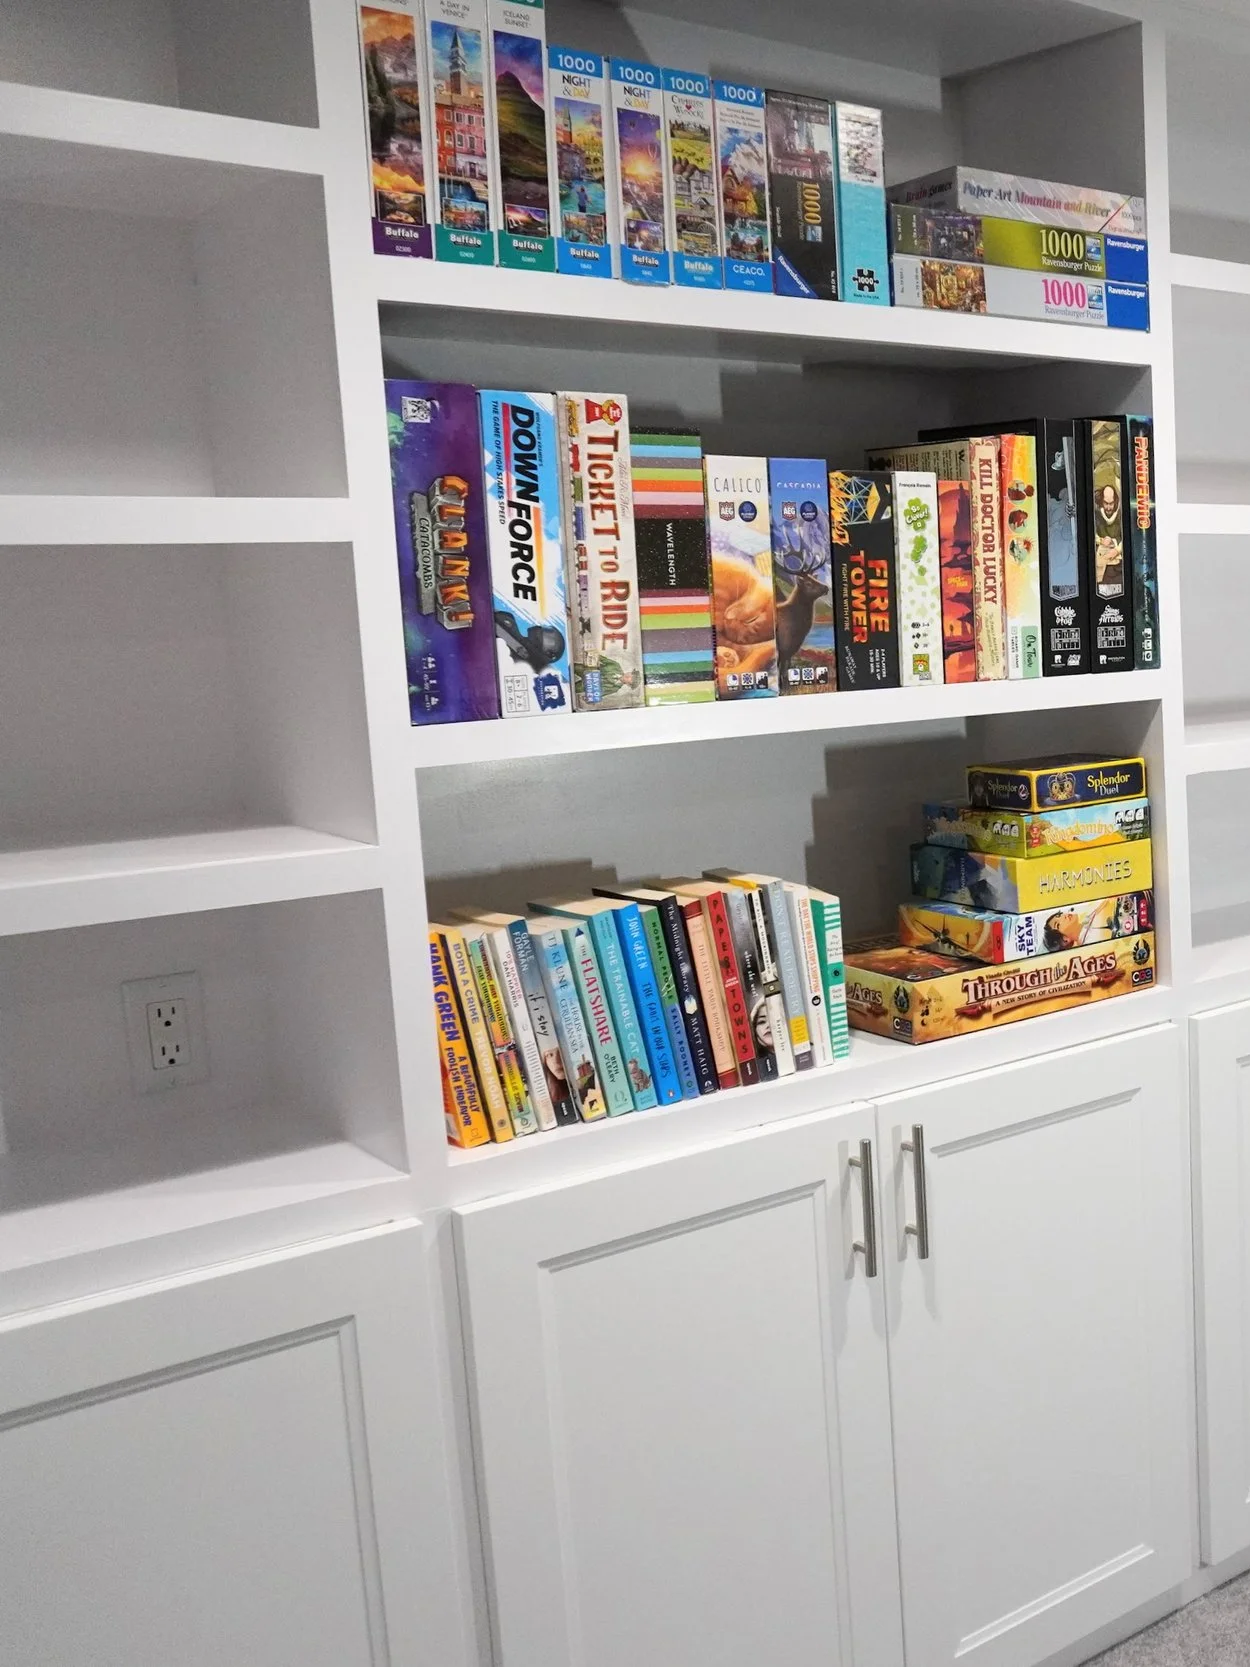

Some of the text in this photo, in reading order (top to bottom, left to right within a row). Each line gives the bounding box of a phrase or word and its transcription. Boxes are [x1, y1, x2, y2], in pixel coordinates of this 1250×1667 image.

[503, 10, 530, 21] ICELAND
[504, 18, 529, 29] SUNSET
[557, 54, 595, 73] 1000
[619, 66, 654, 84] 1000
[562, 74, 591, 88] NIGHT
[563, 86, 590, 98] & DAY
[624, 85, 651, 98] NIGHT
[670, 77, 704, 94] 1000
[723, 85, 757, 102] 1000
[632, 98, 649, 109] DAY
[802, 182, 821, 224] 1000
[963, 180, 993, 199] Paper
[995, 189, 1012, 201] Art
[1015, 190, 1062, 210] Mountain
[1064, 199, 1082, 211] and
[1084, 200, 1110, 217] River
[385, 227, 419, 239] Buffalo
[450, 234, 482, 246] Buffalo
[512, 239, 543, 251] Buffalo
[1040, 229, 1084, 261] 1000
[1106, 237, 1145, 252] Ravensburger
[570, 247, 599, 259] Buffalo
[632, 254, 660, 266] Buffalo
[684, 260, 714, 272] Buffalo
[1042, 256, 1103, 273] Ravensburger Puzzle
[778, 255, 810, 294] Ravensburger
[857, 276, 874, 285] 1000
[1042, 279, 1087, 309] 1000
[1107, 285, 1146, 299] Ravensburger
[1045, 305, 1105, 320] Ravensburger Puzzle
[495, 440, 501, 451] OF
[714, 477, 761, 493] CALICO
[979, 458, 991, 489] KILL
[1135, 436, 1151, 529] PANDEMIC
[720, 507, 734, 516] AEG
[906, 508, 928, 524] Clover!
[980, 494, 995, 553] DOCTOR
[419, 517, 433, 588] CATACOMBS
[587, 429, 631, 650] TICKET TO RIDE
[666, 523, 677, 586] WAVELENGTH
[983, 557, 997, 604] LUCKY
[850, 550, 868, 643] TOWER
[868, 560, 890, 632] FIRE
[988, 779, 1018, 792] Splendor
[1087, 771, 1130, 792] Splendor
[1100, 784, 1119, 796] Duel
[1043, 819, 1115, 845] Kingdomino
[1040, 860, 1133, 894] HARMONIES
[773, 888, 786, 928] DON'T
[800, 898, 808, 908] THE
[802, 909, 810, 919] DAY
[512, 931, 529, 971] FORMAN
[520, 932, 534, 961] GAYLE
[780, 931, 794, 965] READ
[805, 930, 814, 948] WORLD
[1017, 925, 1025, 952] SKY
[548, 935, 567, 991] TJ KLUNE
[652, 922, 673, 999] NORMAL PEOPLE
[744, 950, 753, 970] where
[503, 961, 519, 1008] DAN HARRIS
[505, 951, 522, 999] 10% HAPPIER
[712, 899, 749, 1053] PAPER TOWNS
[747, 970, 755, 981] she
[812, 967, 821, 992] SHOPPING
[963, 953, 1117, 1005] THROUGH the AGES
[1132, 970, 1152, 982] CGE
[429, 943, 461, 1042] HANK GREEN
[581, 959, 612, 1046] FLATSHARE
[607, 944, 639, 1054] THE TRAINABLE CAT
[626, 917, 672, 1078] JOHN GREEN THE IN OUR STARS
[671, 923, 685, 960] Midnight
[679, 961, 690, 992] Library
[690, 1018, 703, 1045] MATT
[698, 1048, 709, 1075] HAIG
[698, 944, 725, 1051] THE LITTLE PARIS BOOKSHOP
[751, 984, 759, 997] went
[785, 966, 800, 1017] POETRY
[852, 982, 883, 1004] AGES
[1002, 997, 1015, 1005] NEW
[1017, 993, 1037, 1002] STORY
[1048, 981, 1086, 995] CIVILIZATION
[453, 943, 499, 1108] BORN A CRIME TREVOR NOAH
[528, 991, 544, 1002] if
[537, 1016, 549, 1037] stay
[560, 998, 578, 1053] CERULEAN SEA
[571, 1006, 581, 1031] HOUSE
[671, 1008, 690, 1077] SALLY ROONEY
[604, 1053, 616, 1083] O'LEARY
[611, 1056, 620, 1075] BETH
[445, 1047, 472, 1126] FOOLISH ENDEAVOR
[457, 1056, 480, 1112] A BEAUTIFULLY
